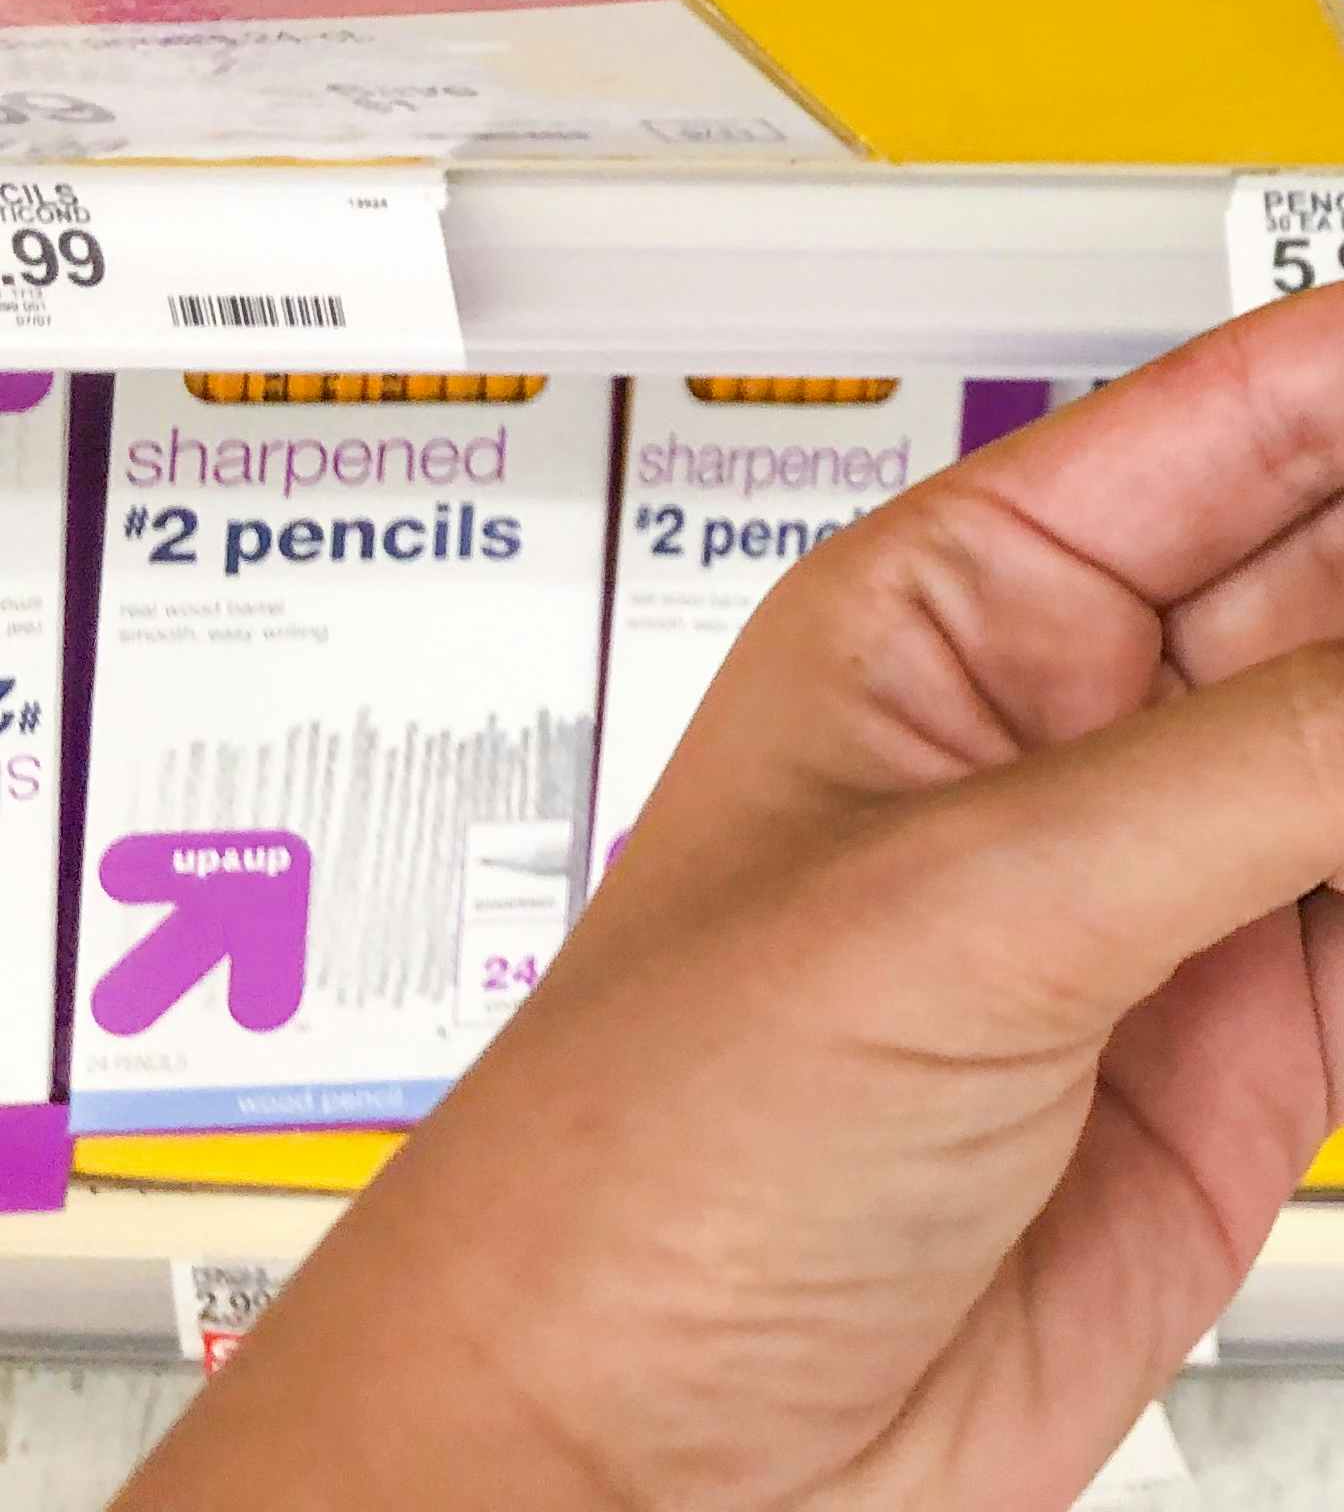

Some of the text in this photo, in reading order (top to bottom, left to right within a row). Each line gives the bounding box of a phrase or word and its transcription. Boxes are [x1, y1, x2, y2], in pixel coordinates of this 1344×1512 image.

[125, 427, 509, 498] sharpened
[638, 433, 912, 495] sharpened
[125, 505, 522, 576] #2 pencils
[636, 504, 686, 557] #2
[481, 953, 541, 991] 24
[320, 1087, 405, 1117] pencil
